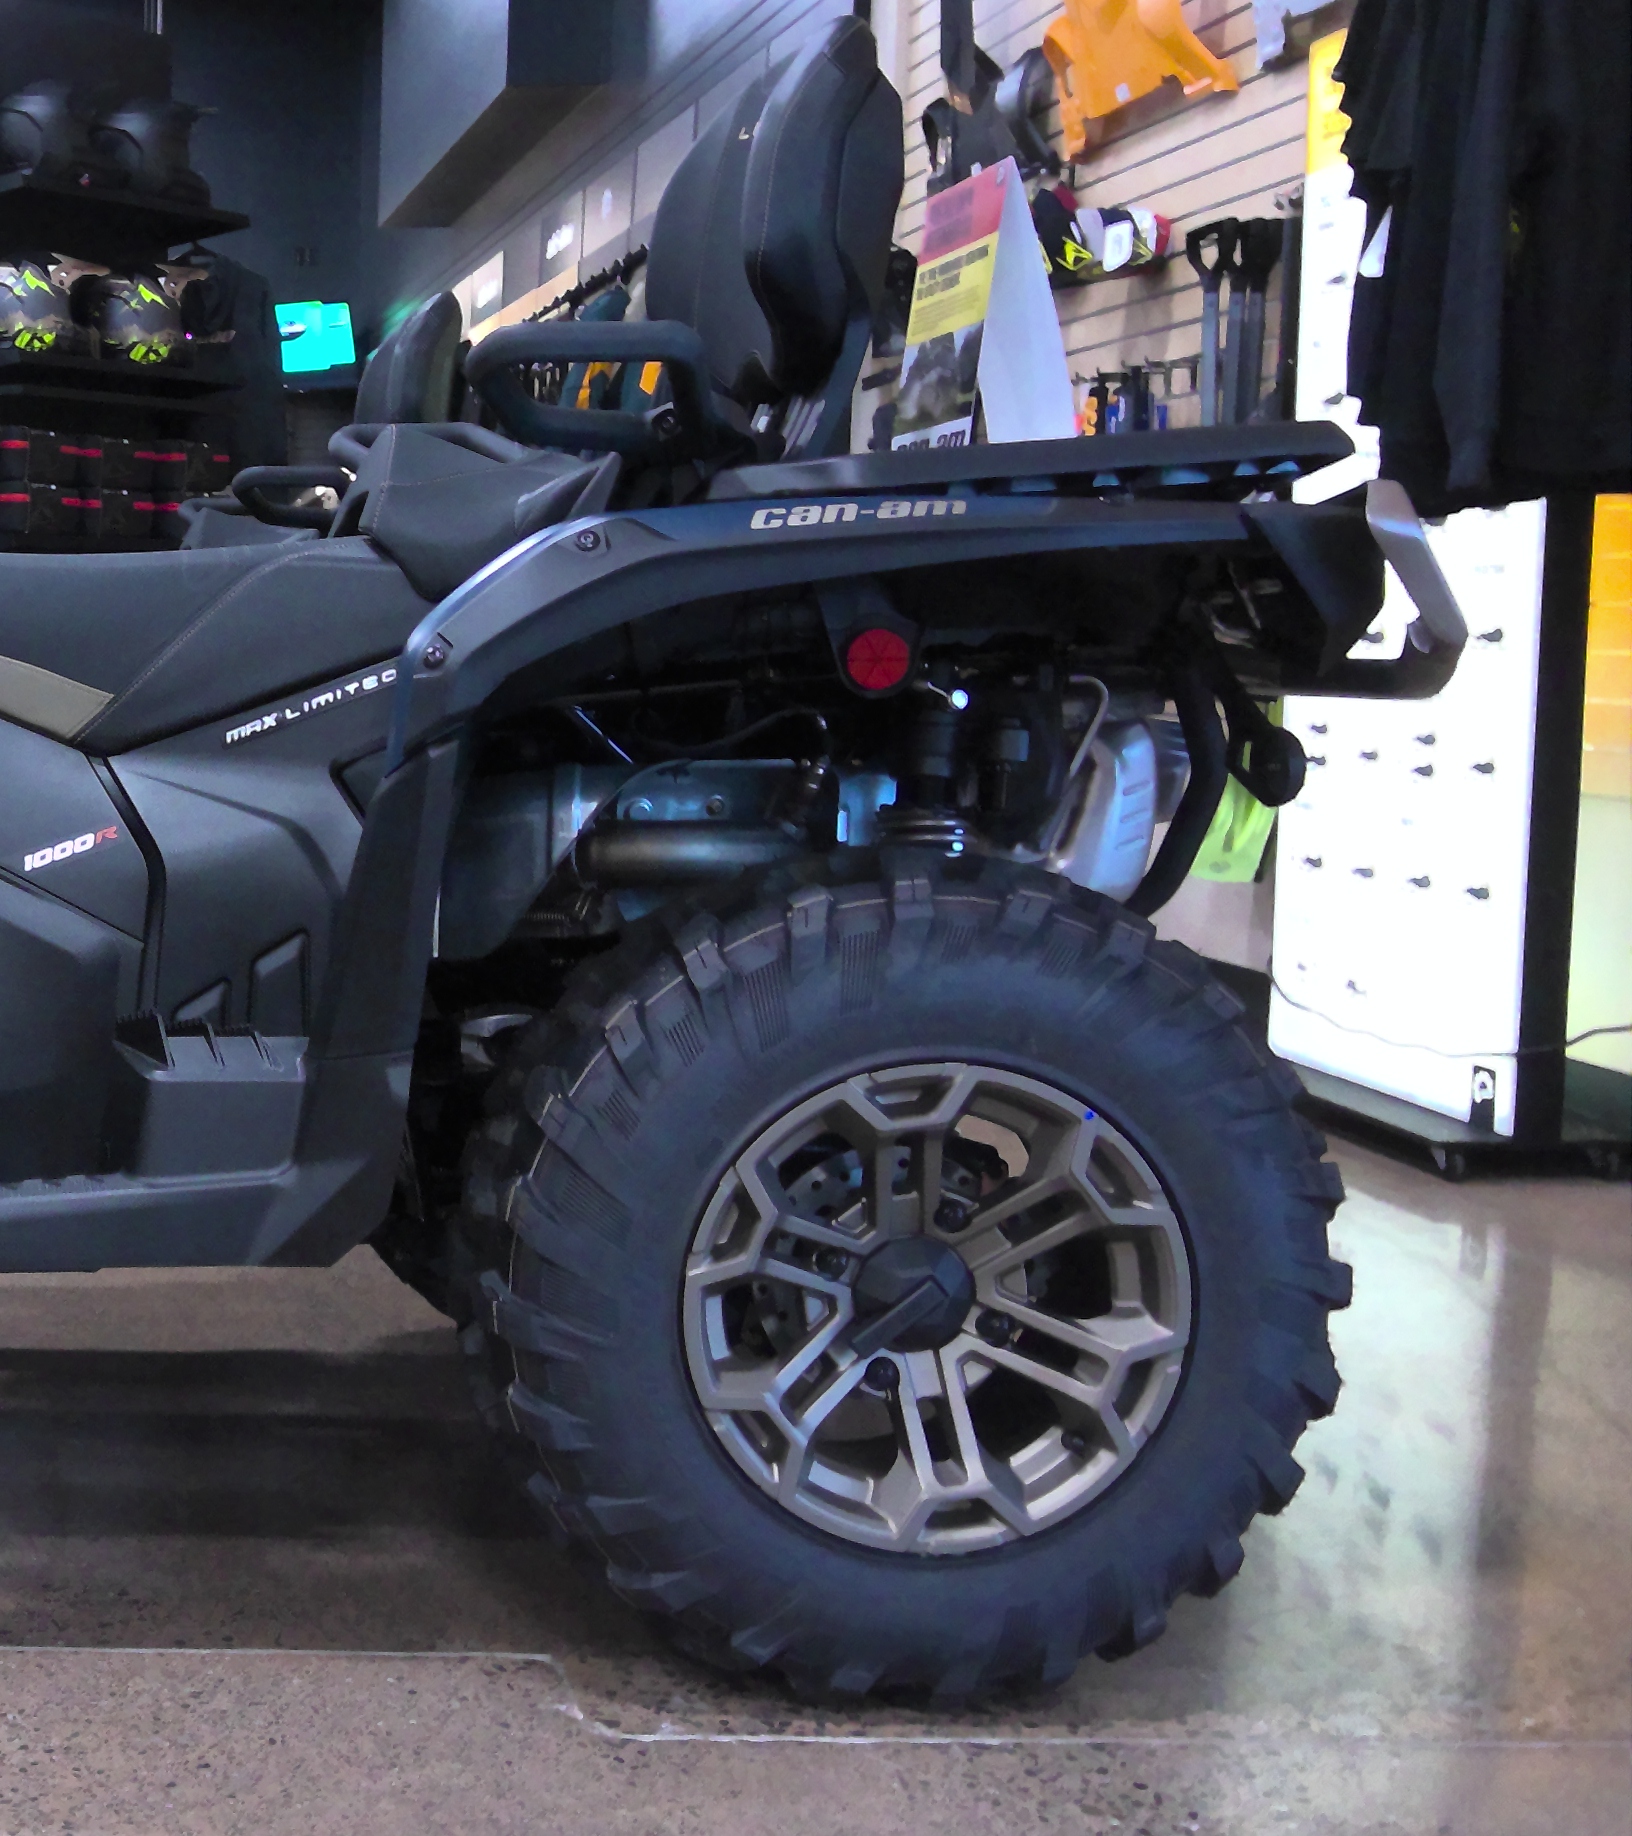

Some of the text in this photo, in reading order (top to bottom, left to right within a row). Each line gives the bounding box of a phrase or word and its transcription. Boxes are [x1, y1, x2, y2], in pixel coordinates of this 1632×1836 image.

[750, 500, 967, 530] can-am
[225, 668, 397, 744] MAX LIMITED
[24, 826, 118, 871] 1000R
